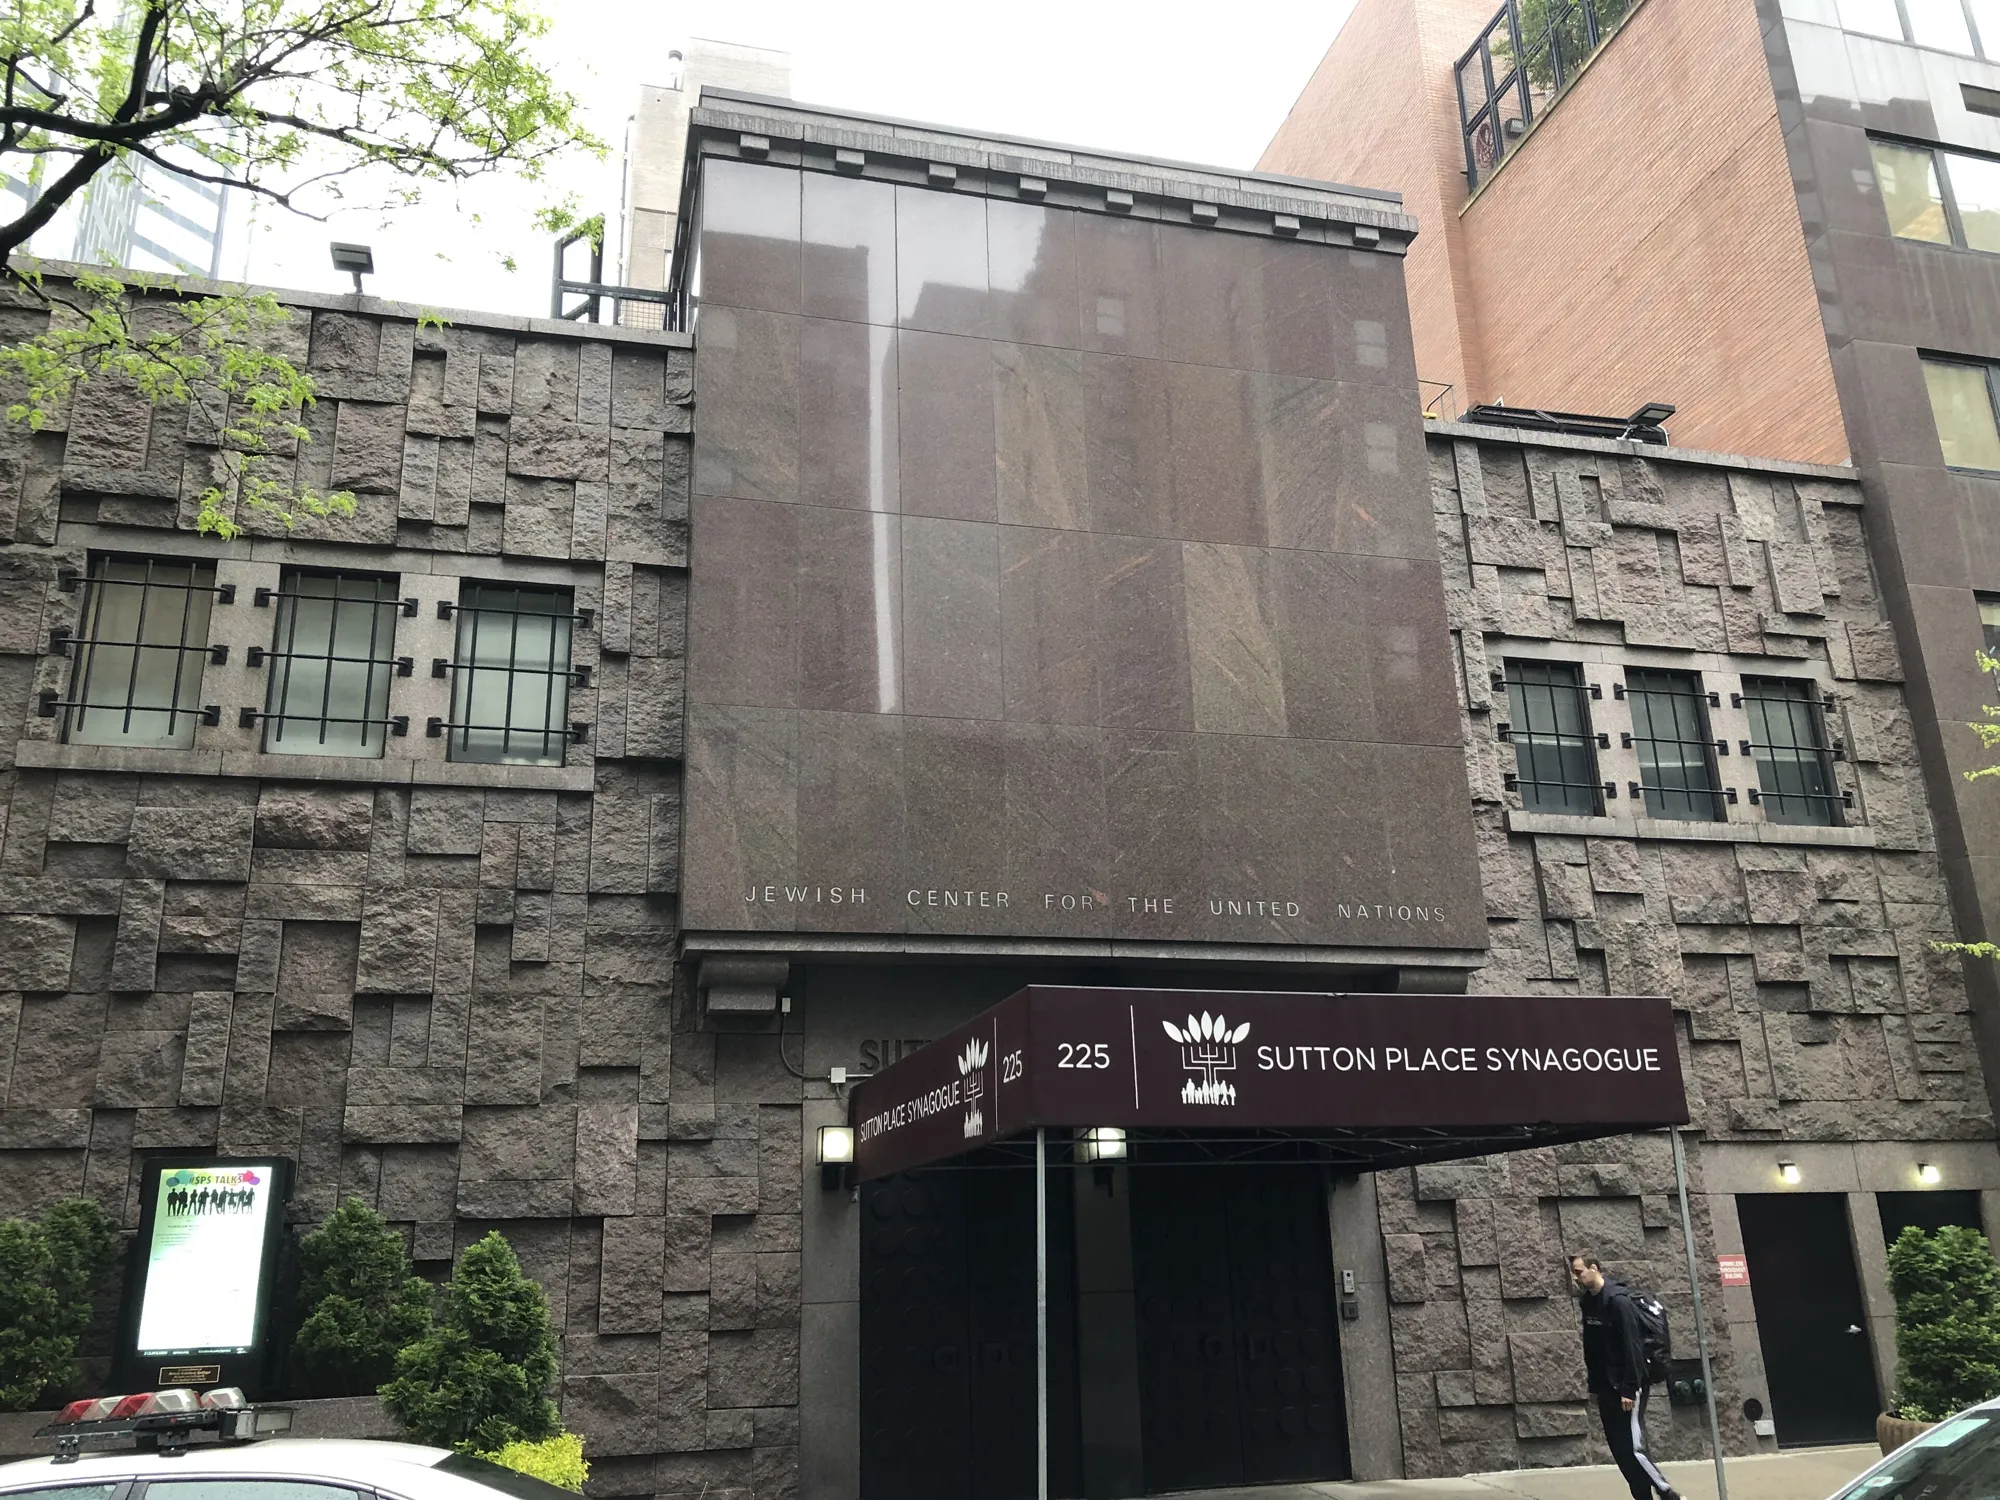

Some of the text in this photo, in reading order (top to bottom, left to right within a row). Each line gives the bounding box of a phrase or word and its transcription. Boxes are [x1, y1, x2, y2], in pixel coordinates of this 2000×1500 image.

[745, 886, 1446, 922] JEWISH CENTER FOR THE UNITED NATIONS
[1002, 1049, 1023, 1084] 225
[1057, 1043, 1110, 1069] 225
[1257, 1045, 1661, 1072] SUTTON PLACE SYNAGOGUE
[860, 1080, 960, 1143] SUTTON PLACE SYNAGOGUE
[215, 1175, 244, 1184] TALKS
